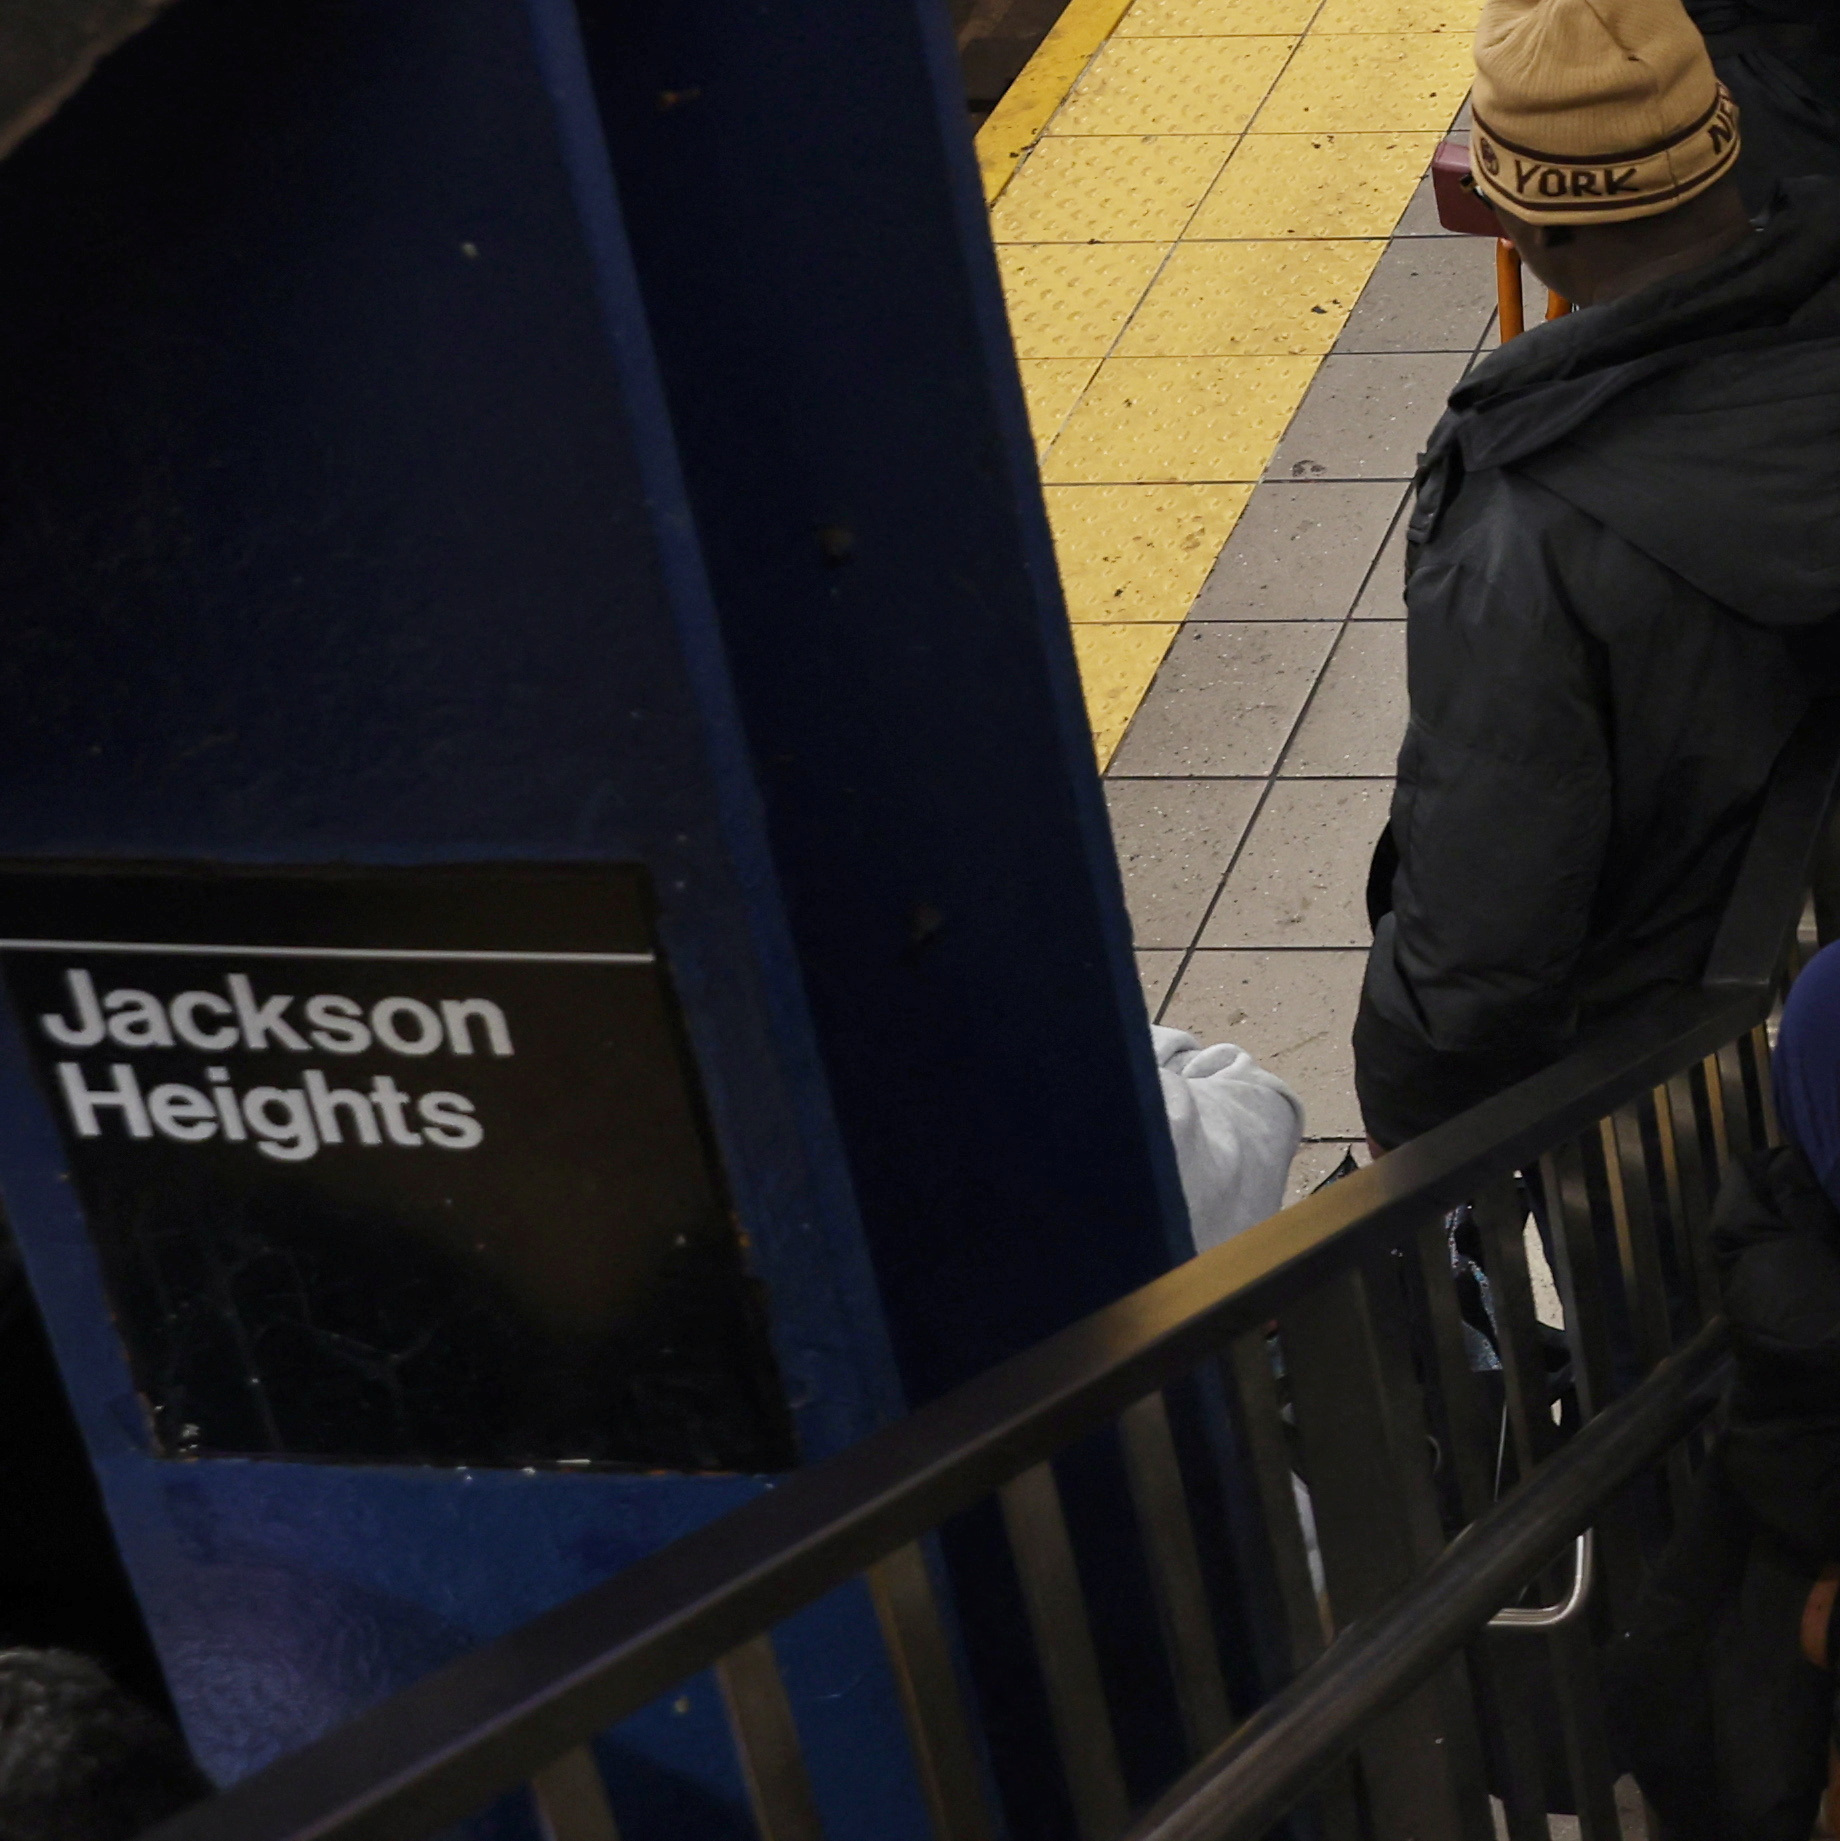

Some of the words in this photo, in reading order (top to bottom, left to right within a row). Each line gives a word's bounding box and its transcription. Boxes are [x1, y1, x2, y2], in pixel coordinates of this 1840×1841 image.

[1513, 159, 1641, 198] YORK
[42, 969, 514, 1057] Jackson
[57, 1062, 484, 1162] Heights
